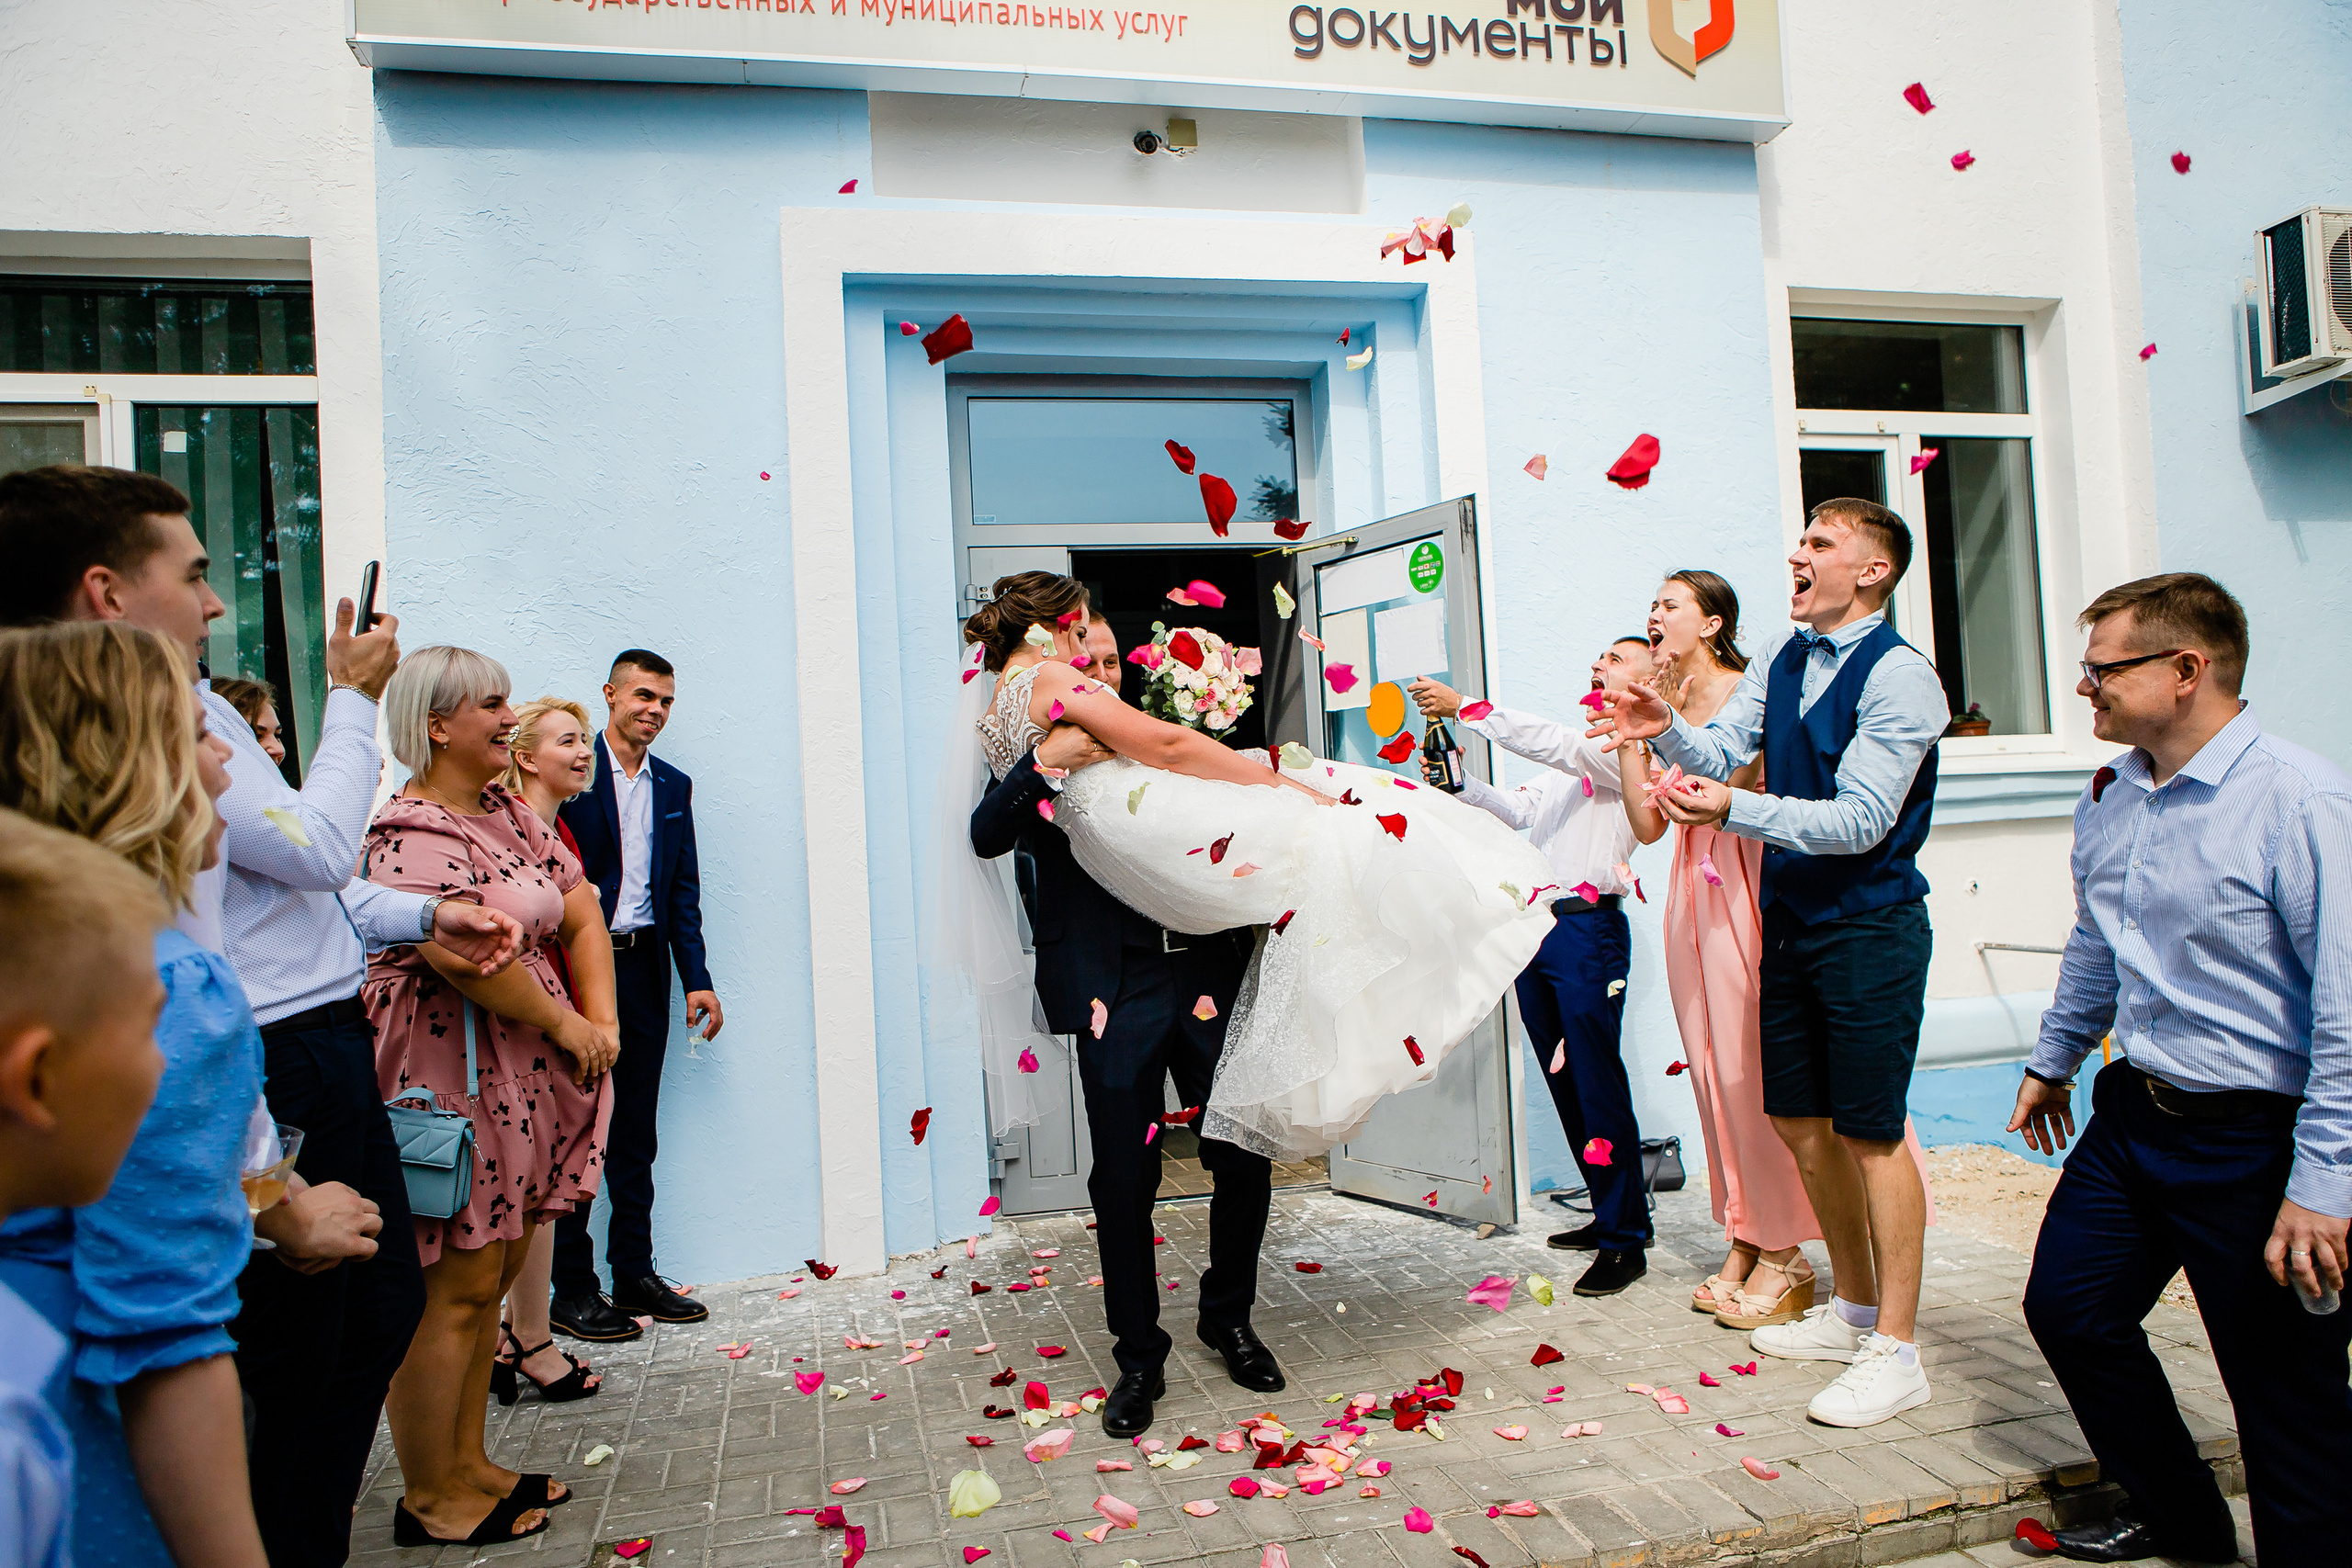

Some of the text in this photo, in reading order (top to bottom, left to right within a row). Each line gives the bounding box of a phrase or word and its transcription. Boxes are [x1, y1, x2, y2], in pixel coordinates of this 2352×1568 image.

[831, 0, 846, 16] и
[861, 0, 1104, 29] муниципальных
[1114, 10, 1188, 42] услуг
[1288, 3, 1628, 67] документы
